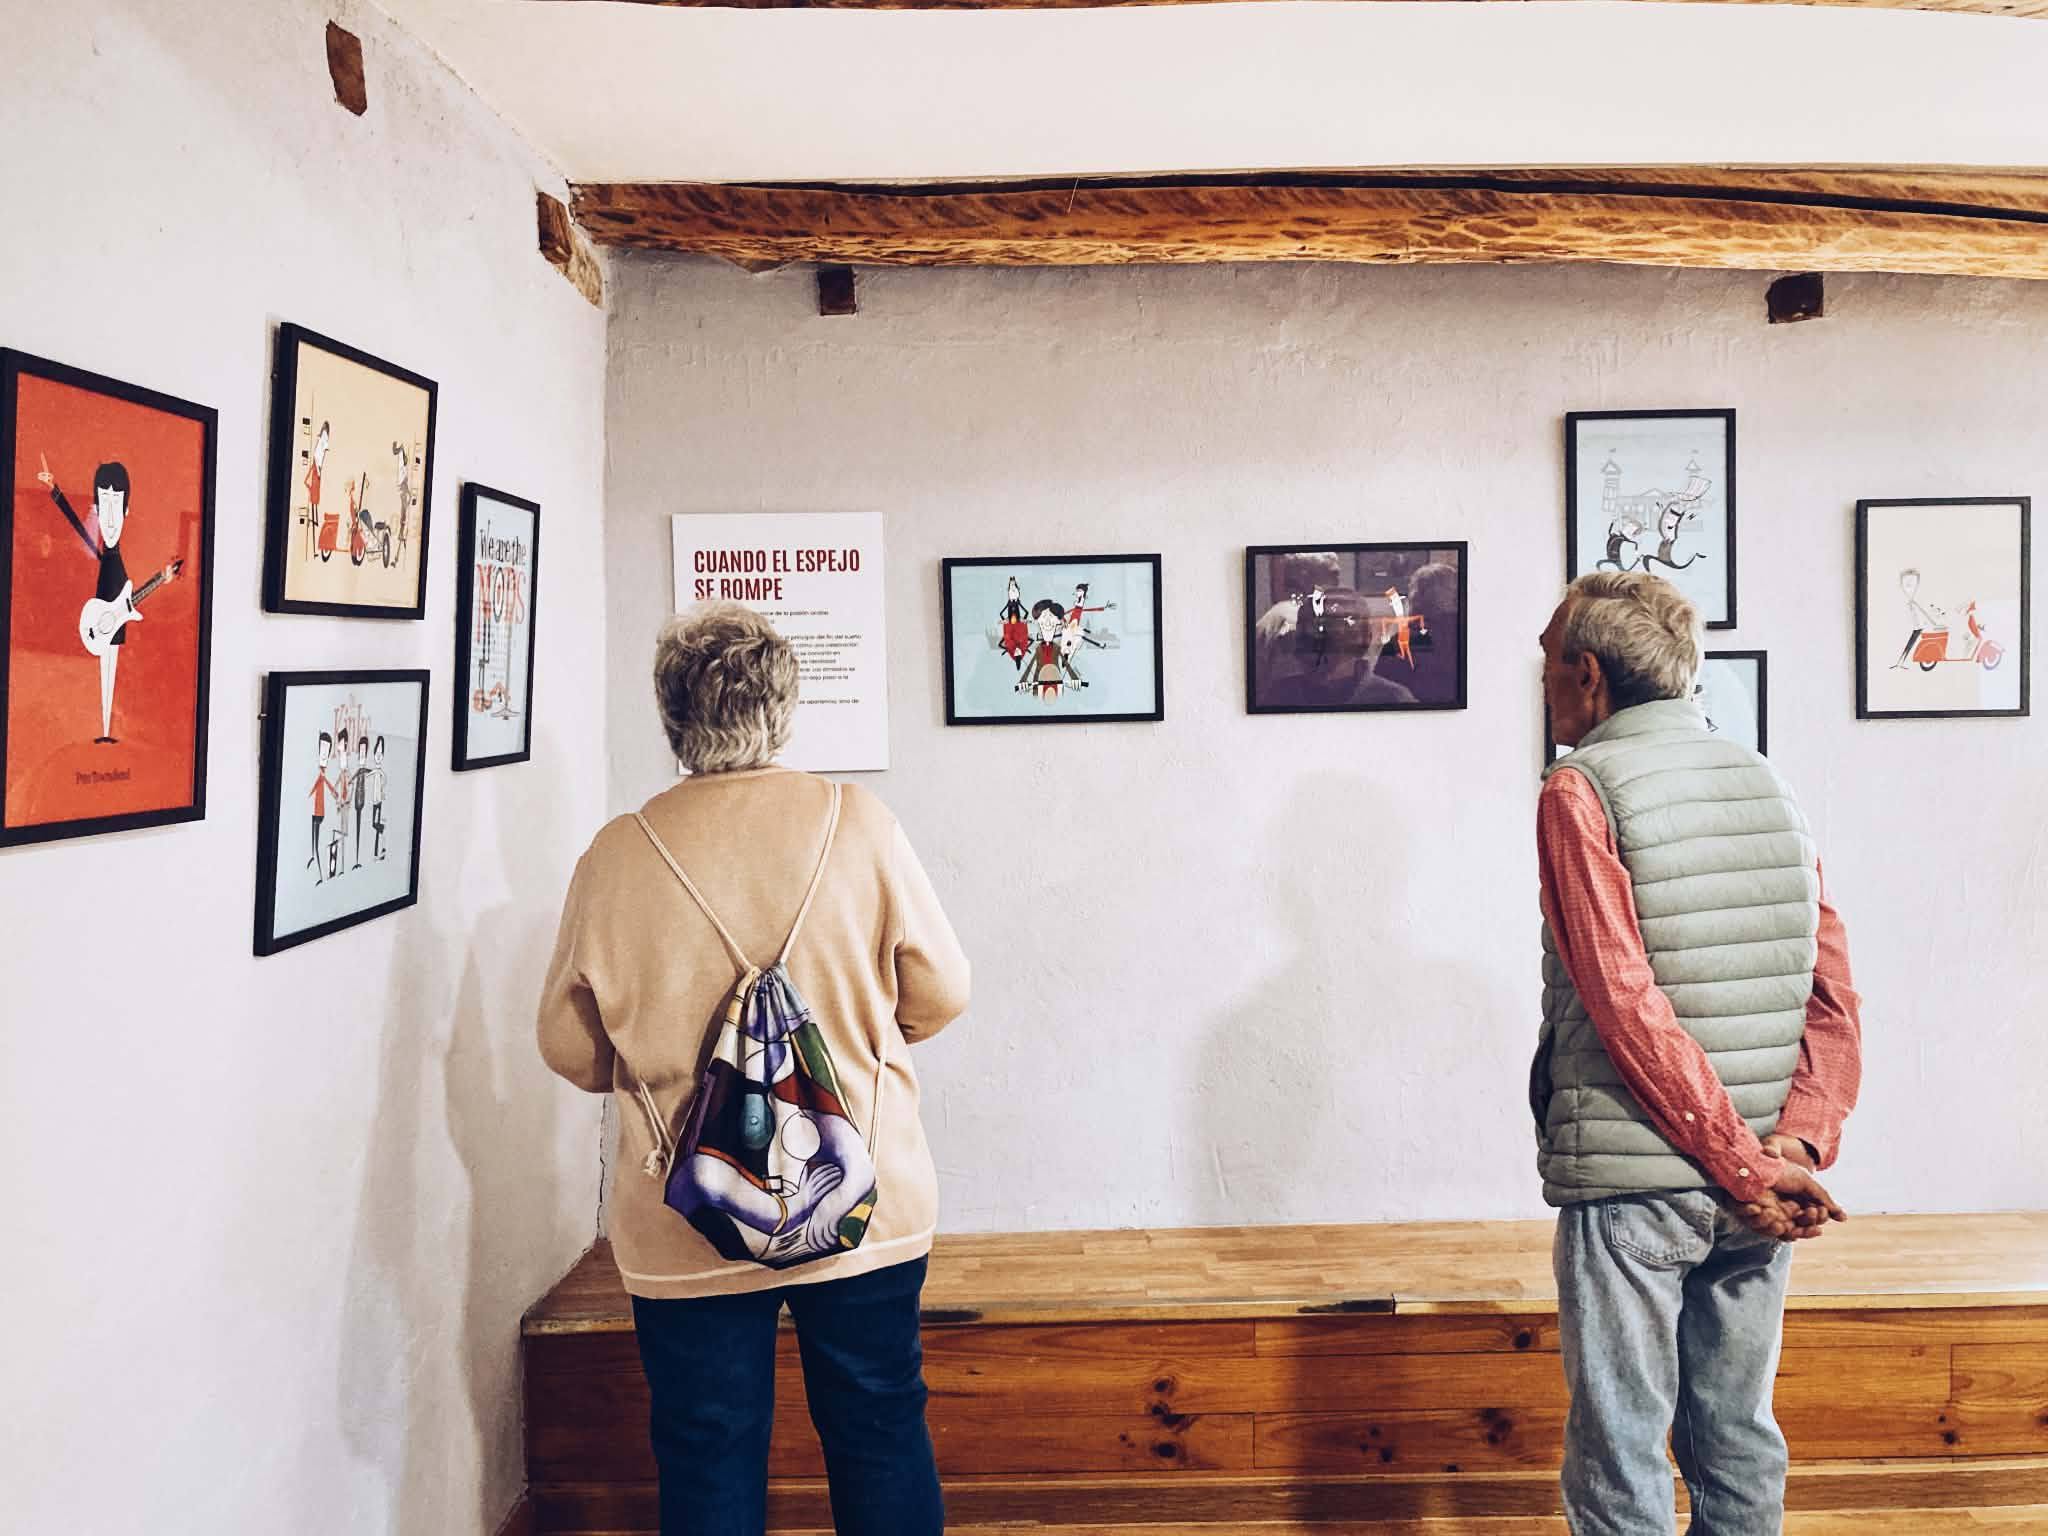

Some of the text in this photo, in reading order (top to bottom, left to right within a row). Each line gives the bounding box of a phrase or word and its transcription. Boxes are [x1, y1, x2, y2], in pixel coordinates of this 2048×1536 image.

[694, 549, 860, 573] CUANDO EL ESPEJO
[694, 578, 783, 600] SE ROMPE
